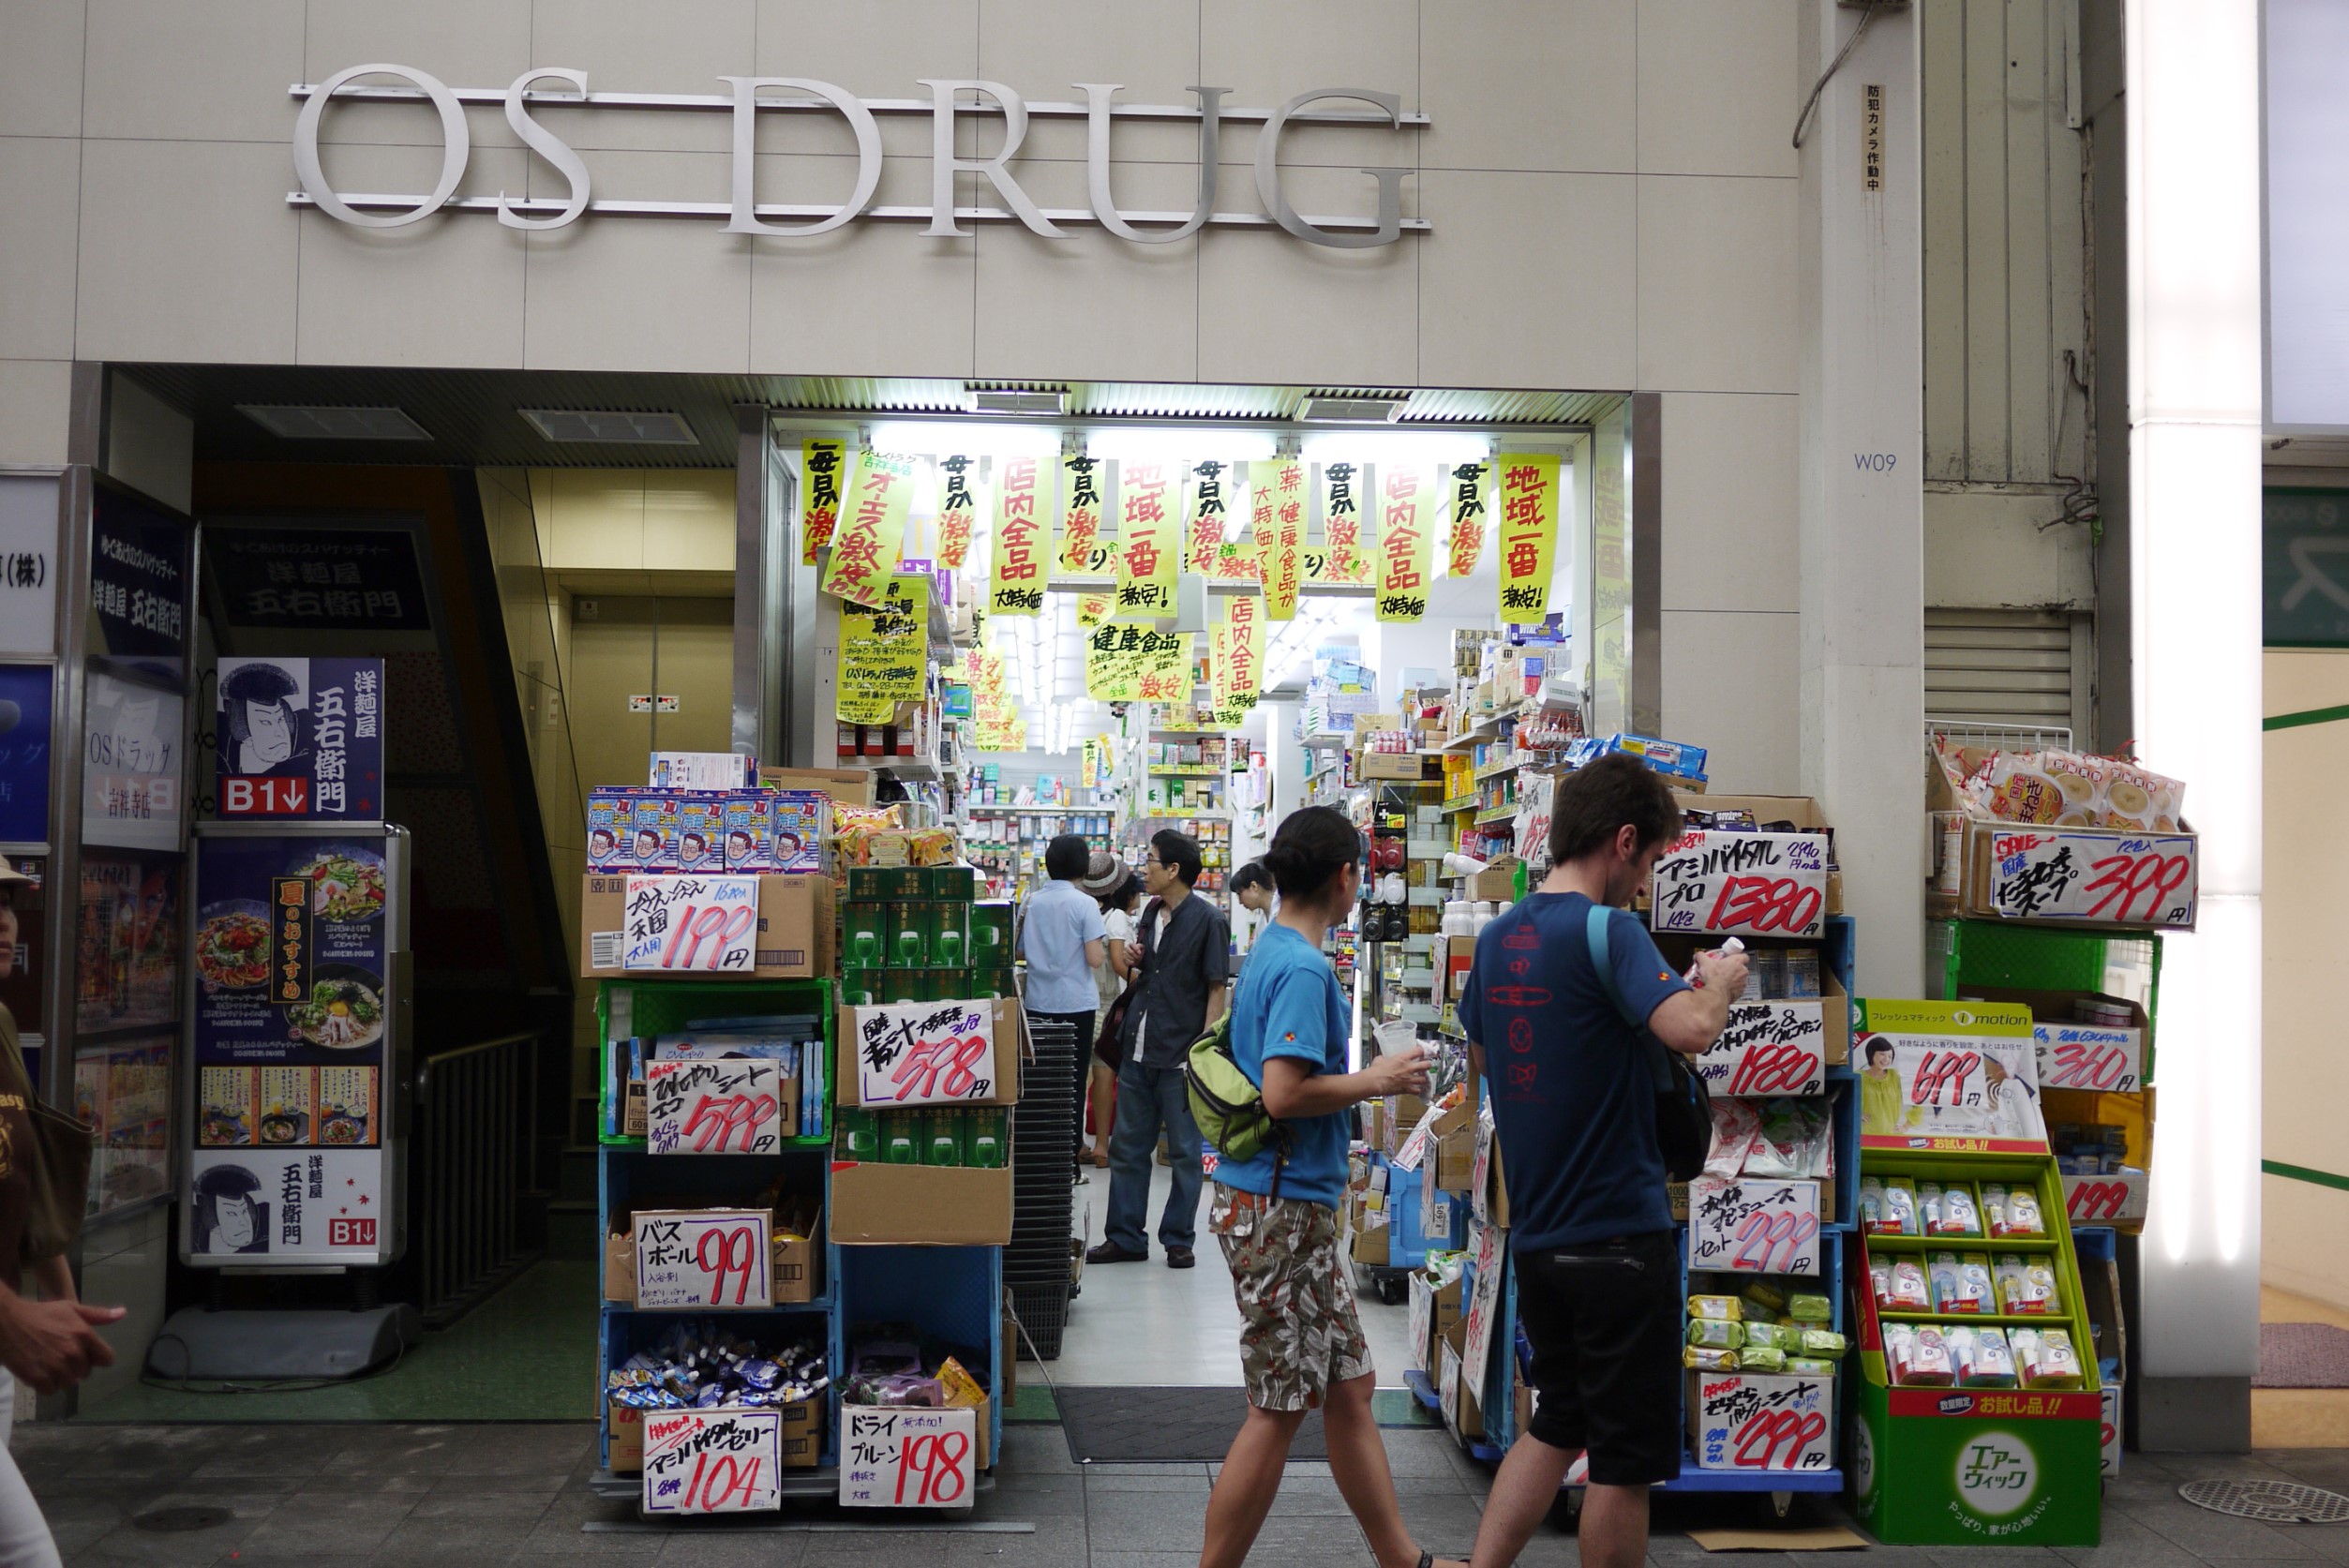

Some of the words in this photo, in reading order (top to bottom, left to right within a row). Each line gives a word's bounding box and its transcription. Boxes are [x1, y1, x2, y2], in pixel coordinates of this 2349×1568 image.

[1867, 85, 1879, 191] 防犯カメラ作動中
[293, 64, 591, 231] OS
[716, 74, 1416, 249] DRUG
[1854, 454, 1897, 471] W09
[1000, 457, 1040, 581] 店内全品
[1123, 460, 1165, 578] 地域一番
[1383, 465, 1421, 591] 店内全品
[1505, 466, 1549, 579] 地域一番
[995, 587, 1043, 610] 大特価
[1381, 596, 1425, 618] 大特価
[1091, 624, 1180, 652] 健康食品
[354, 670, 377, 739] 洋麺屋
[314, 687, 347, 813] 五右衛門
[108, 789, 151, 820] 吉祥寺店
[228, 780, 277, 812] B1
[279, 880, 306, 1000] 夏のおすすめ
[1872, 1012, 1947, 1023] フレッシュマティック
[1974, 1014, 2028, 1026] motion
[281, 1163, 303, 1246] 五右衛門
[334, 1221, 362, 1244] B1
[639, 1219, 682, 1245] バス
[649, 1244, 698, 1266] ボール
[696, 1226, 755, 1306] 99
[851, 1414, 898, 1437] ドライ
[851, 1441, 902, 1466] プルーン
[893, 1430, 969, 1505] 198
[1966, 1444, 2021, 1470] エアー
[1964, 1469, 2027, 1489] ウィック
